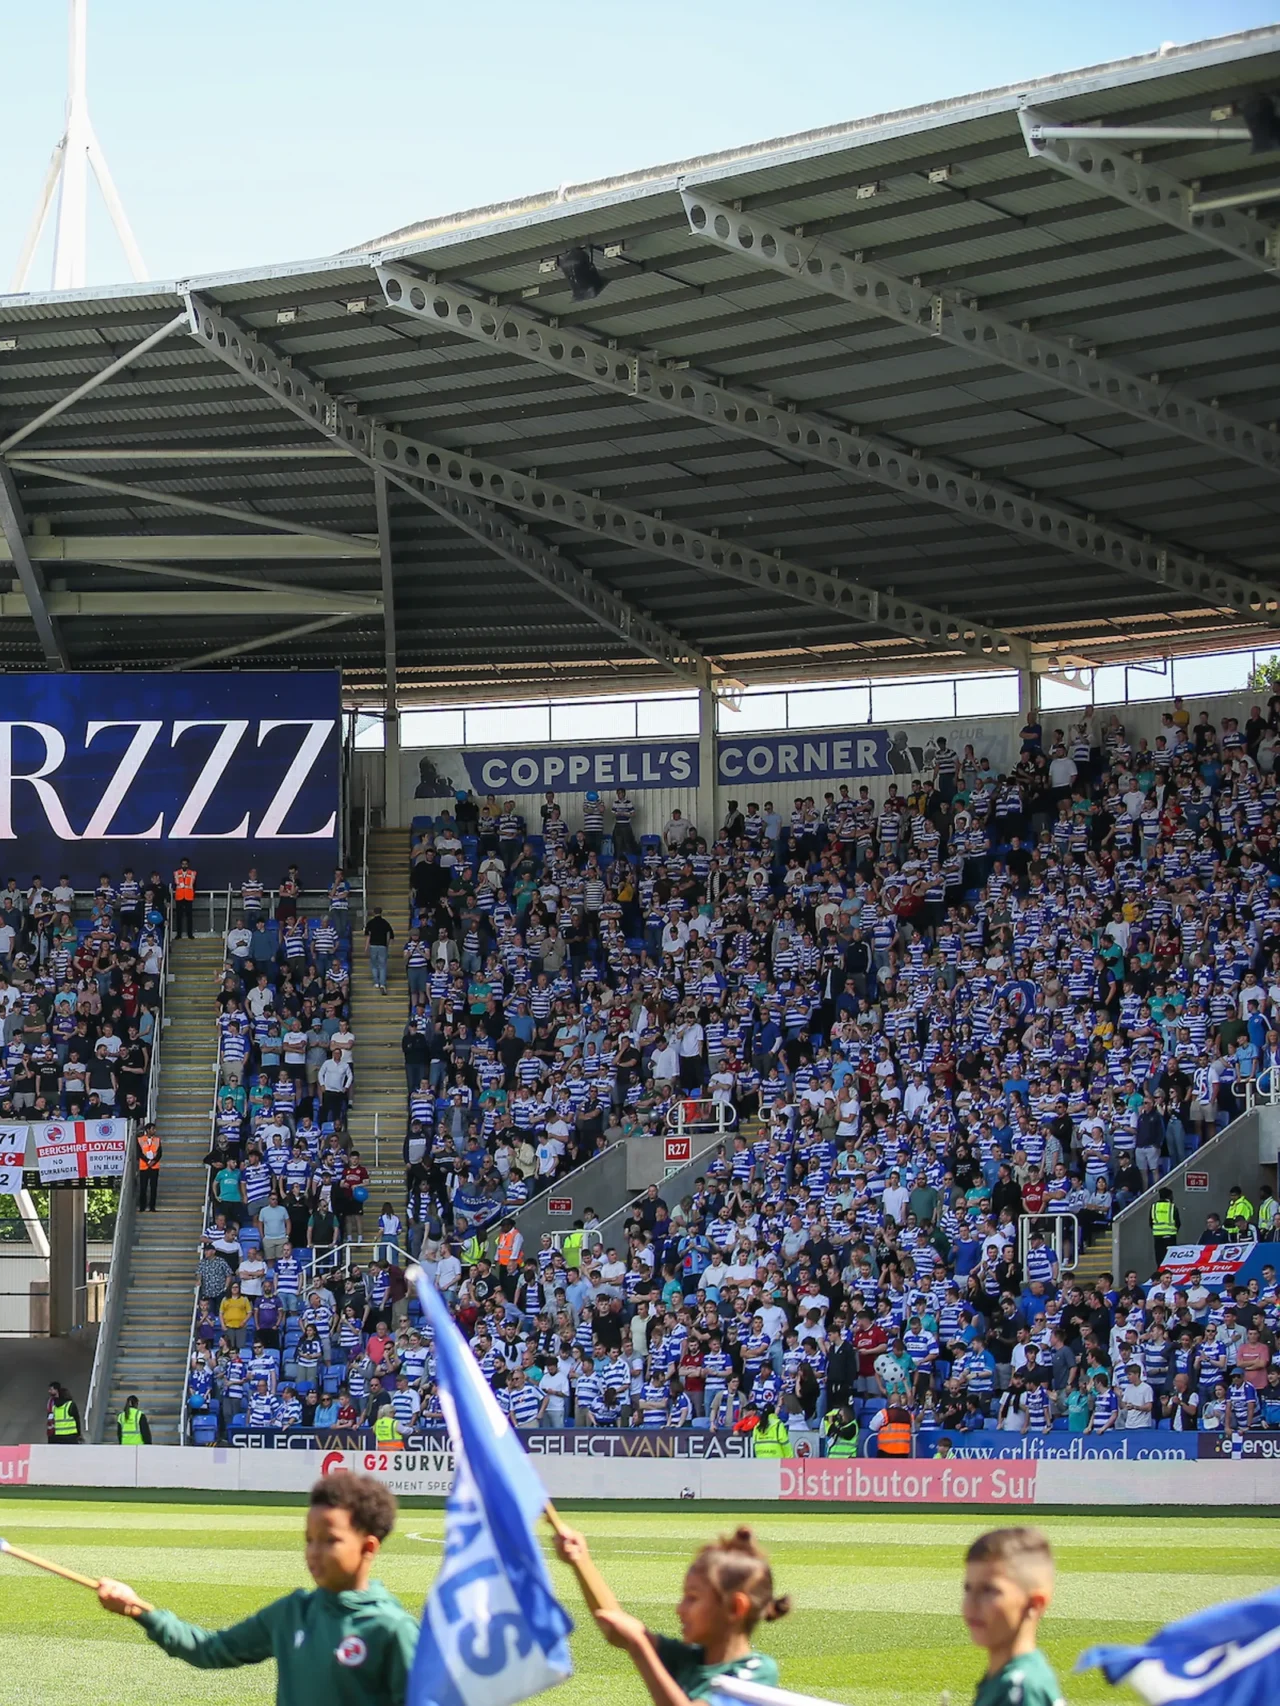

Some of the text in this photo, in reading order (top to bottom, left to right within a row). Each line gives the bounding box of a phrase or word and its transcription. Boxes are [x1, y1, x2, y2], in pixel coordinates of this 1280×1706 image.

[481, 739, 878, 788] COPPELL’S CORNER
[39, 1142, 123, 1157] BERKSHIRE LOYALS
[667, 1142, 688, 1156] R27
[89, 1154, 123, 1162] BROTHERS
[40, 1166, 78, 1177] SURRENDER
[1169, 1249, 1195, 1259] RG42
[1222, 1440, 1280, 1458] eergy
[364, 1454, 455, 1472] G2 SURVE
[780, 1467, 933, 1498] Distributor
[941, 1468, 983, 1498] for
